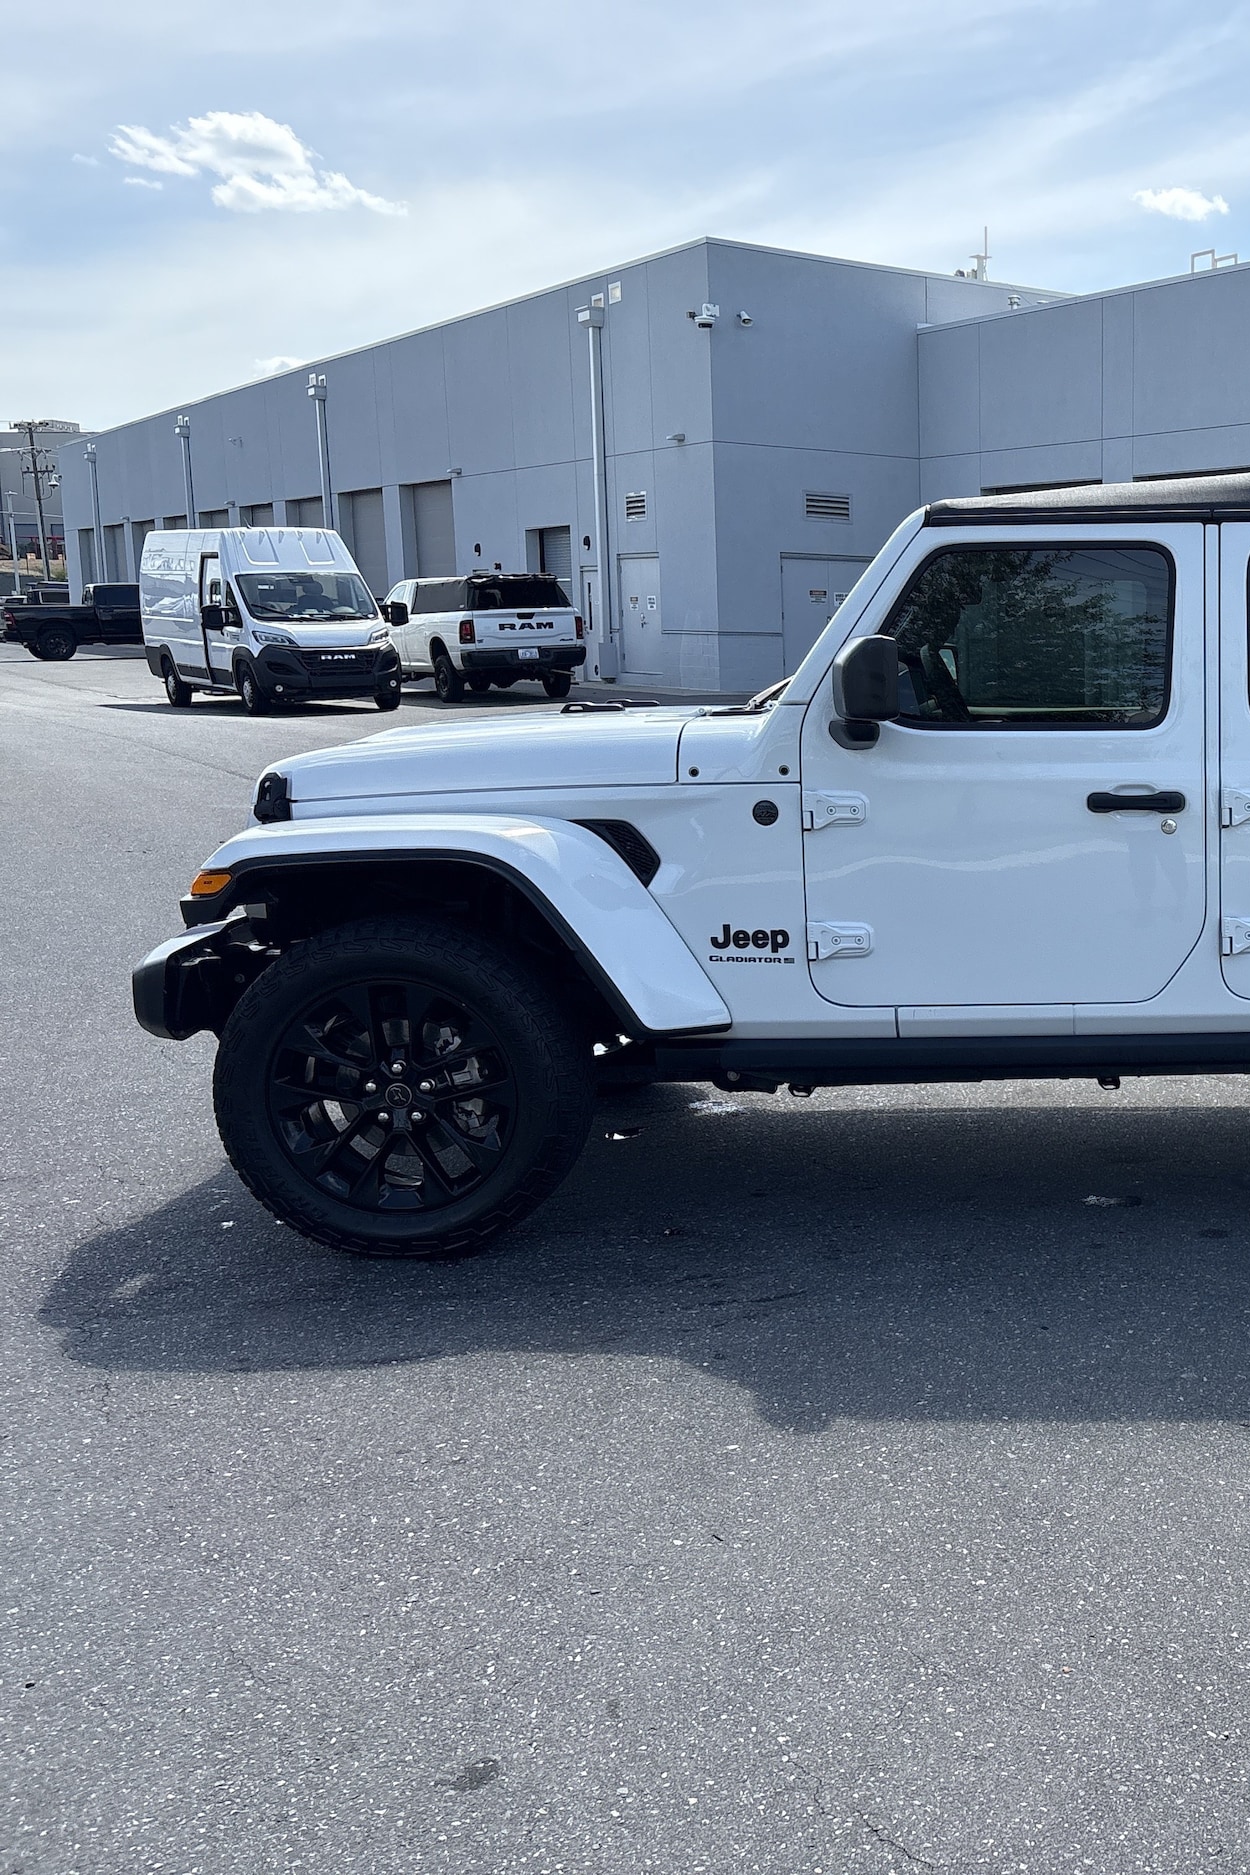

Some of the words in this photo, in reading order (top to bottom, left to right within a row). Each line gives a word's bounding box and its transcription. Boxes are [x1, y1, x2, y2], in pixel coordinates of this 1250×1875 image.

[498, 621, 554, 631] RAM
[710, 923, 790, 953] Jeep
[709, 955, 782, 964] GLADIATOR
